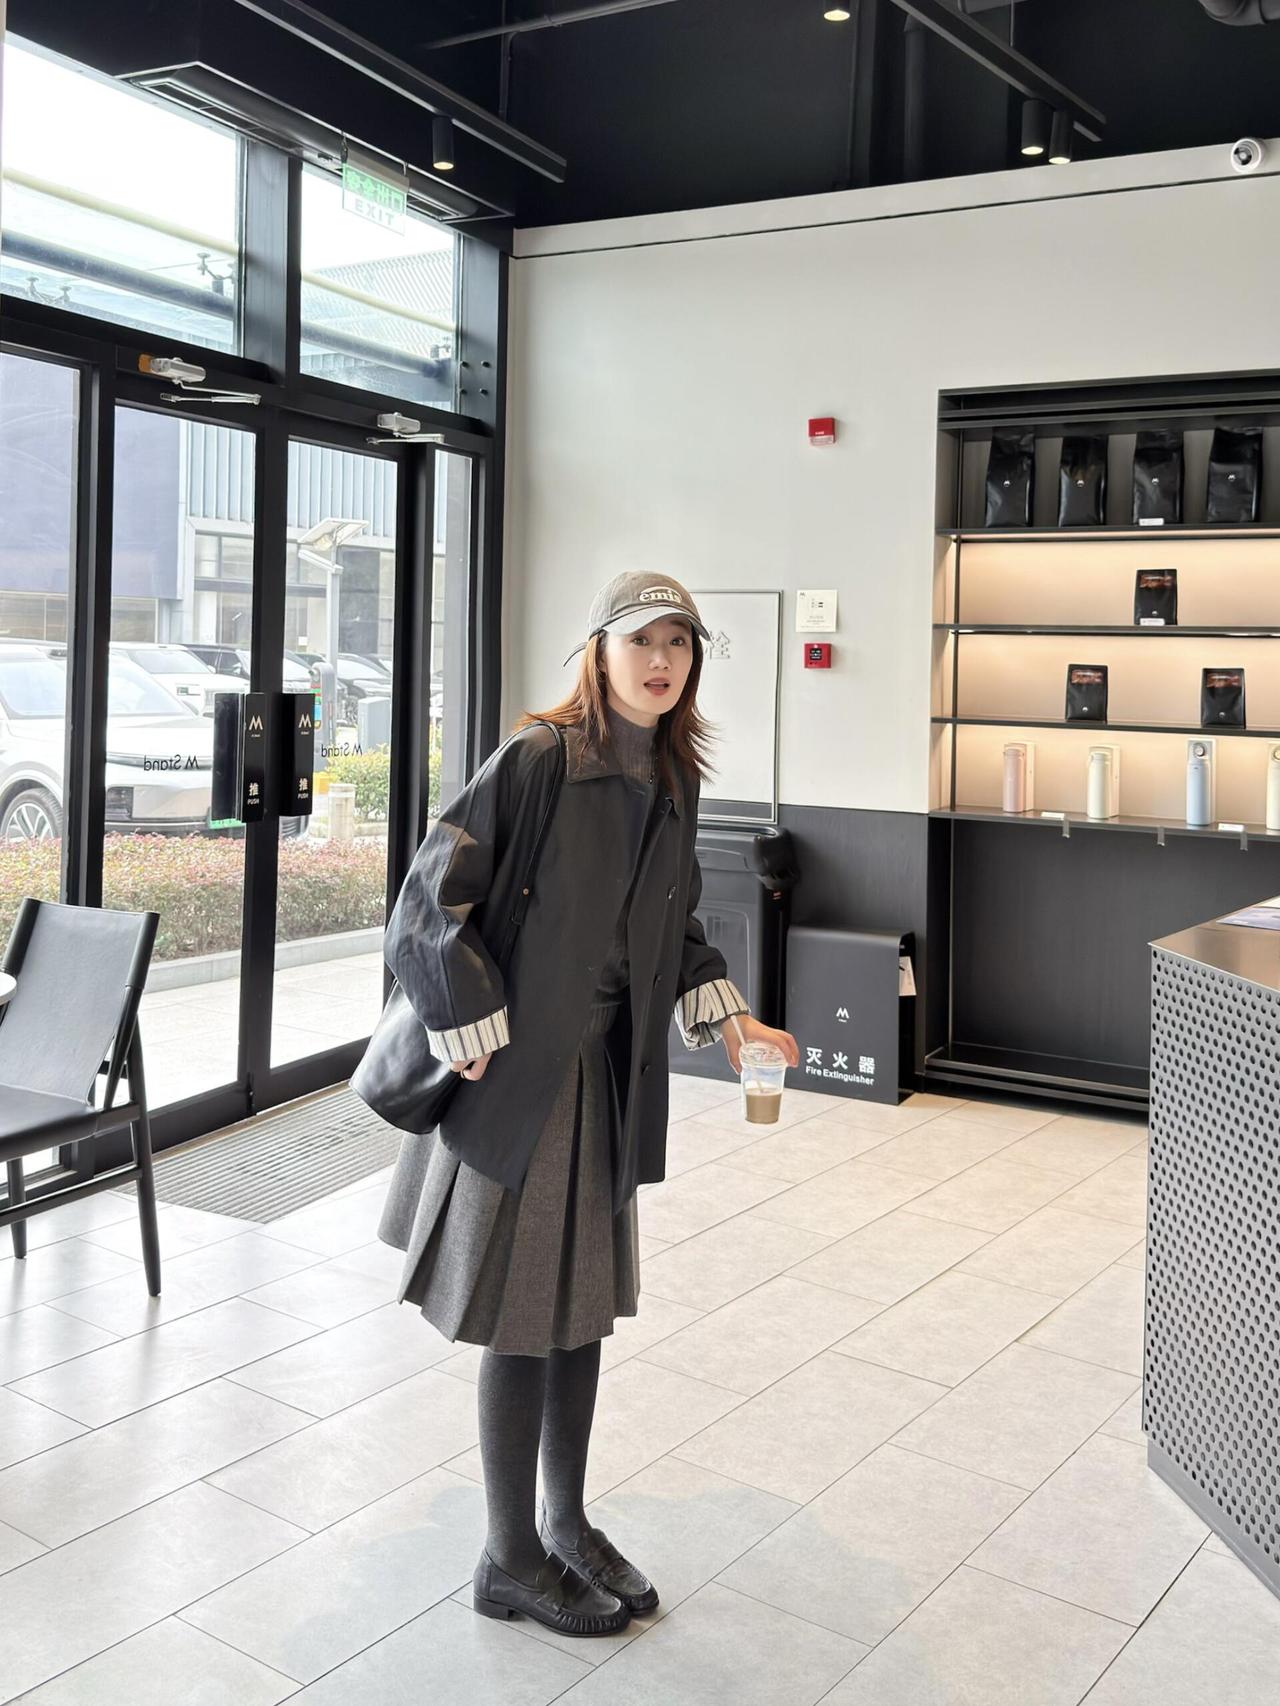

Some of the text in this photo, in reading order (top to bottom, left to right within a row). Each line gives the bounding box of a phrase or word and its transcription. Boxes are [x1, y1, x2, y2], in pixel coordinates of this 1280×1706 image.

[355, 197, 394, 226] EXIT
[248, 782, 259, 796] 推
[298, 778, 309, 791] 推
[805, 1046, 875, 1075] 灭火器
[805, 1065, 875, 1086] Fire Extinguisher
